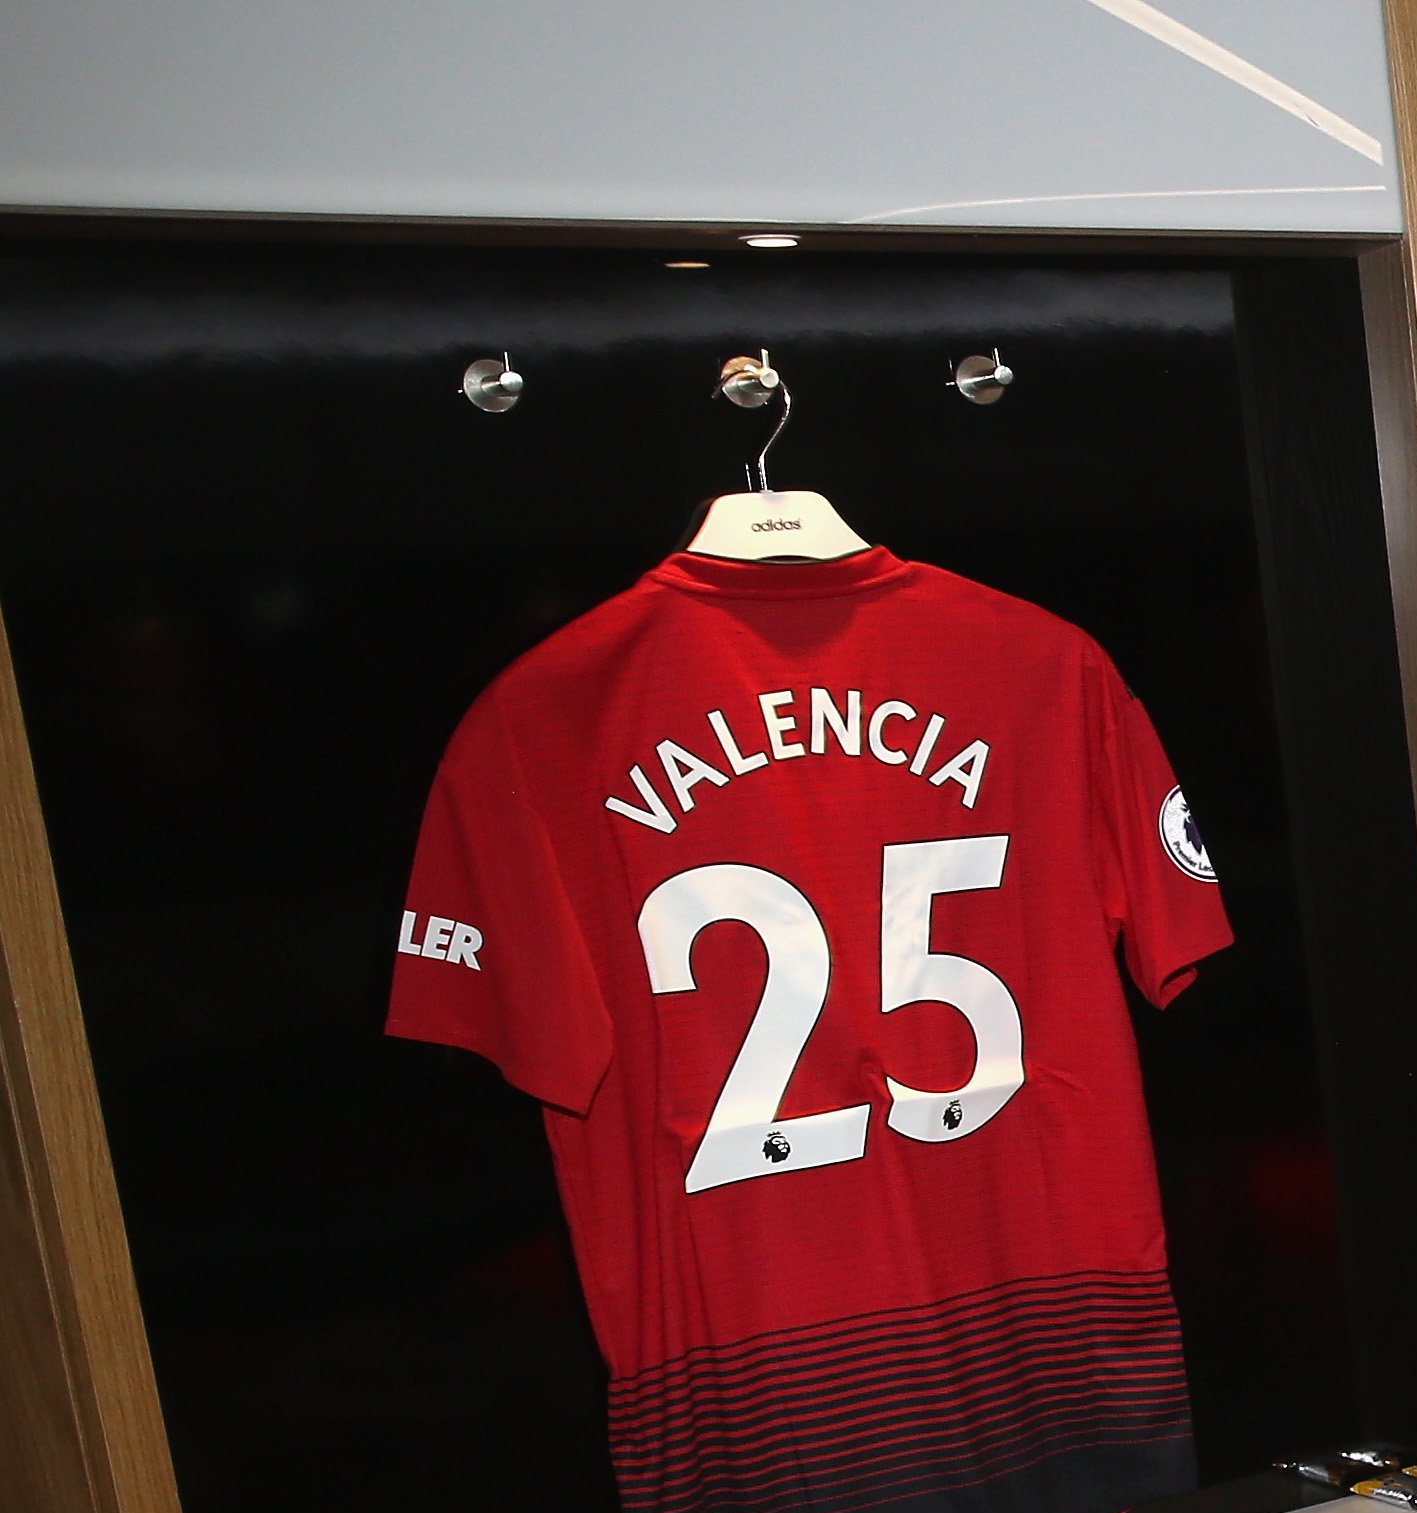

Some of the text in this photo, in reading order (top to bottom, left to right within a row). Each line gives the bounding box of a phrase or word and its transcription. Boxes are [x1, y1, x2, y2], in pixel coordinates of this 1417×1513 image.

[751, 518, 801, 532] adidas
[605, 687, 990, 834] VALENCIA
[637, 835, 1025, 1194] 25
